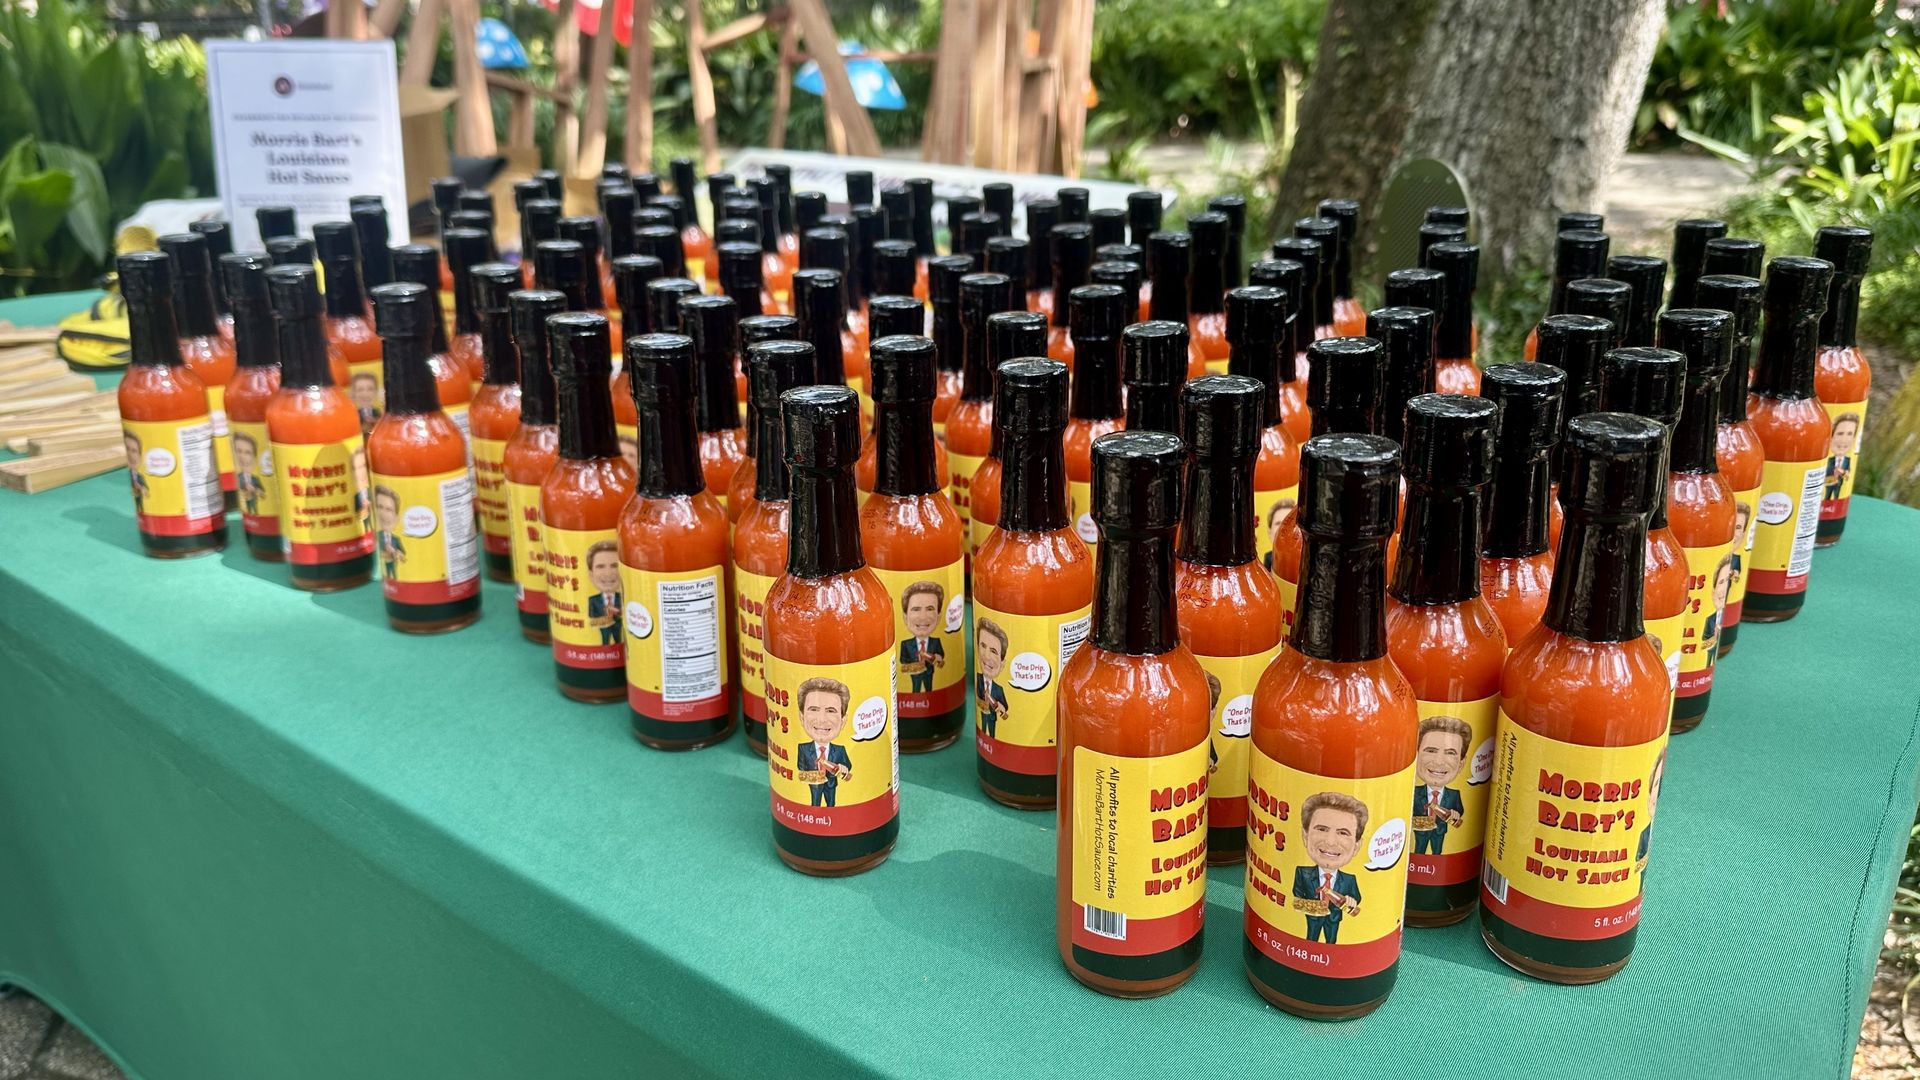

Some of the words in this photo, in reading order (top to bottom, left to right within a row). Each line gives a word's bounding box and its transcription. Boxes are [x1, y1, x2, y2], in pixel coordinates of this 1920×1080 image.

[1110, 767, 1120, 781] All
[1538, 768, 1641, 802] MORRIS
[1107, 781, 1119, 817] profits
[1249, 778, 1290, 821] RRIS
[797, 814, 814, 824] (148
[815, 816, 832, 826] mL)
[1109, 818, 1118, 830] to
[1538, 800, 1635, 833] BART'S
[1108, 831, 1118, 854] local
[1535, 837, 1627, 863] LOUISIANA
[1107, 856, 1118, 899] charities
[1417, 864, 1436, 875] mL)
[1525, 856, 1568, 882] HOT
[1576, 867, 1630, 885] SAUCE
[1145, 876, 1182, 896] HOT
[1594, 918, 1600, 928] 5
[1257, 928, 1262, 938] 5
[1271, 939, 1284, 952] oz.
[1286, 945, 1308, 960] (148
[1310, 951, 1330, 966] mL)
